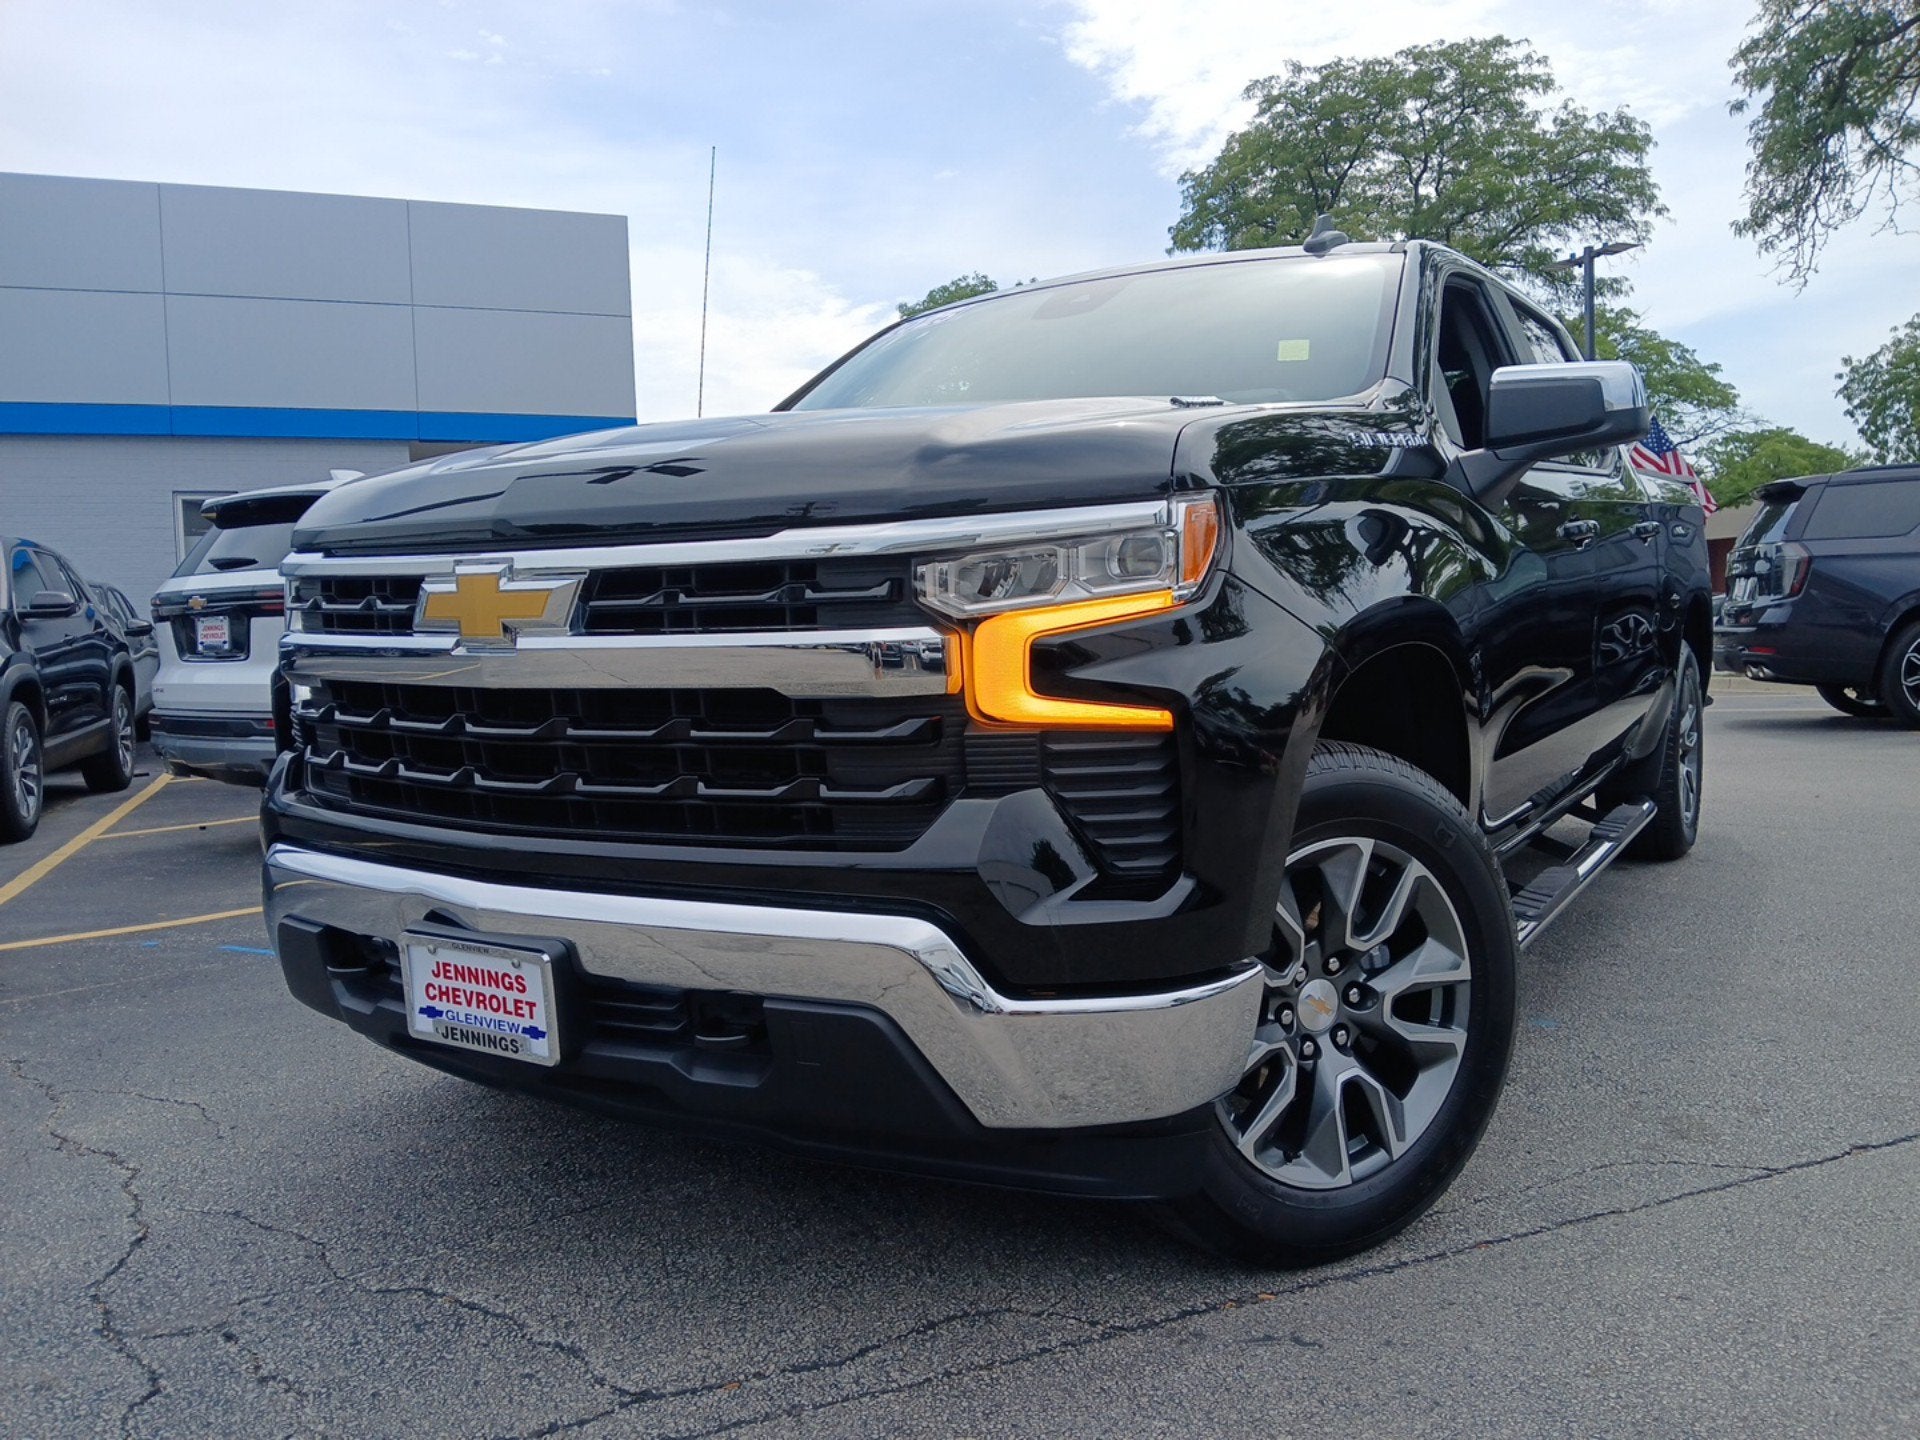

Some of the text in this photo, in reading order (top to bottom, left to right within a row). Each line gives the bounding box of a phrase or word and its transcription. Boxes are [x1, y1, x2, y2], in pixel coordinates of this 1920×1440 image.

[451, 943, 490, 954] GLENVIEW
[431, 961, 528, 994] JENNINGS
[424, 982, 537, 1020] CHEVROLET
[445, 1009, 521, 1034] GLENVIEW
[441, 1025, 520, 1054] JENNINGS
